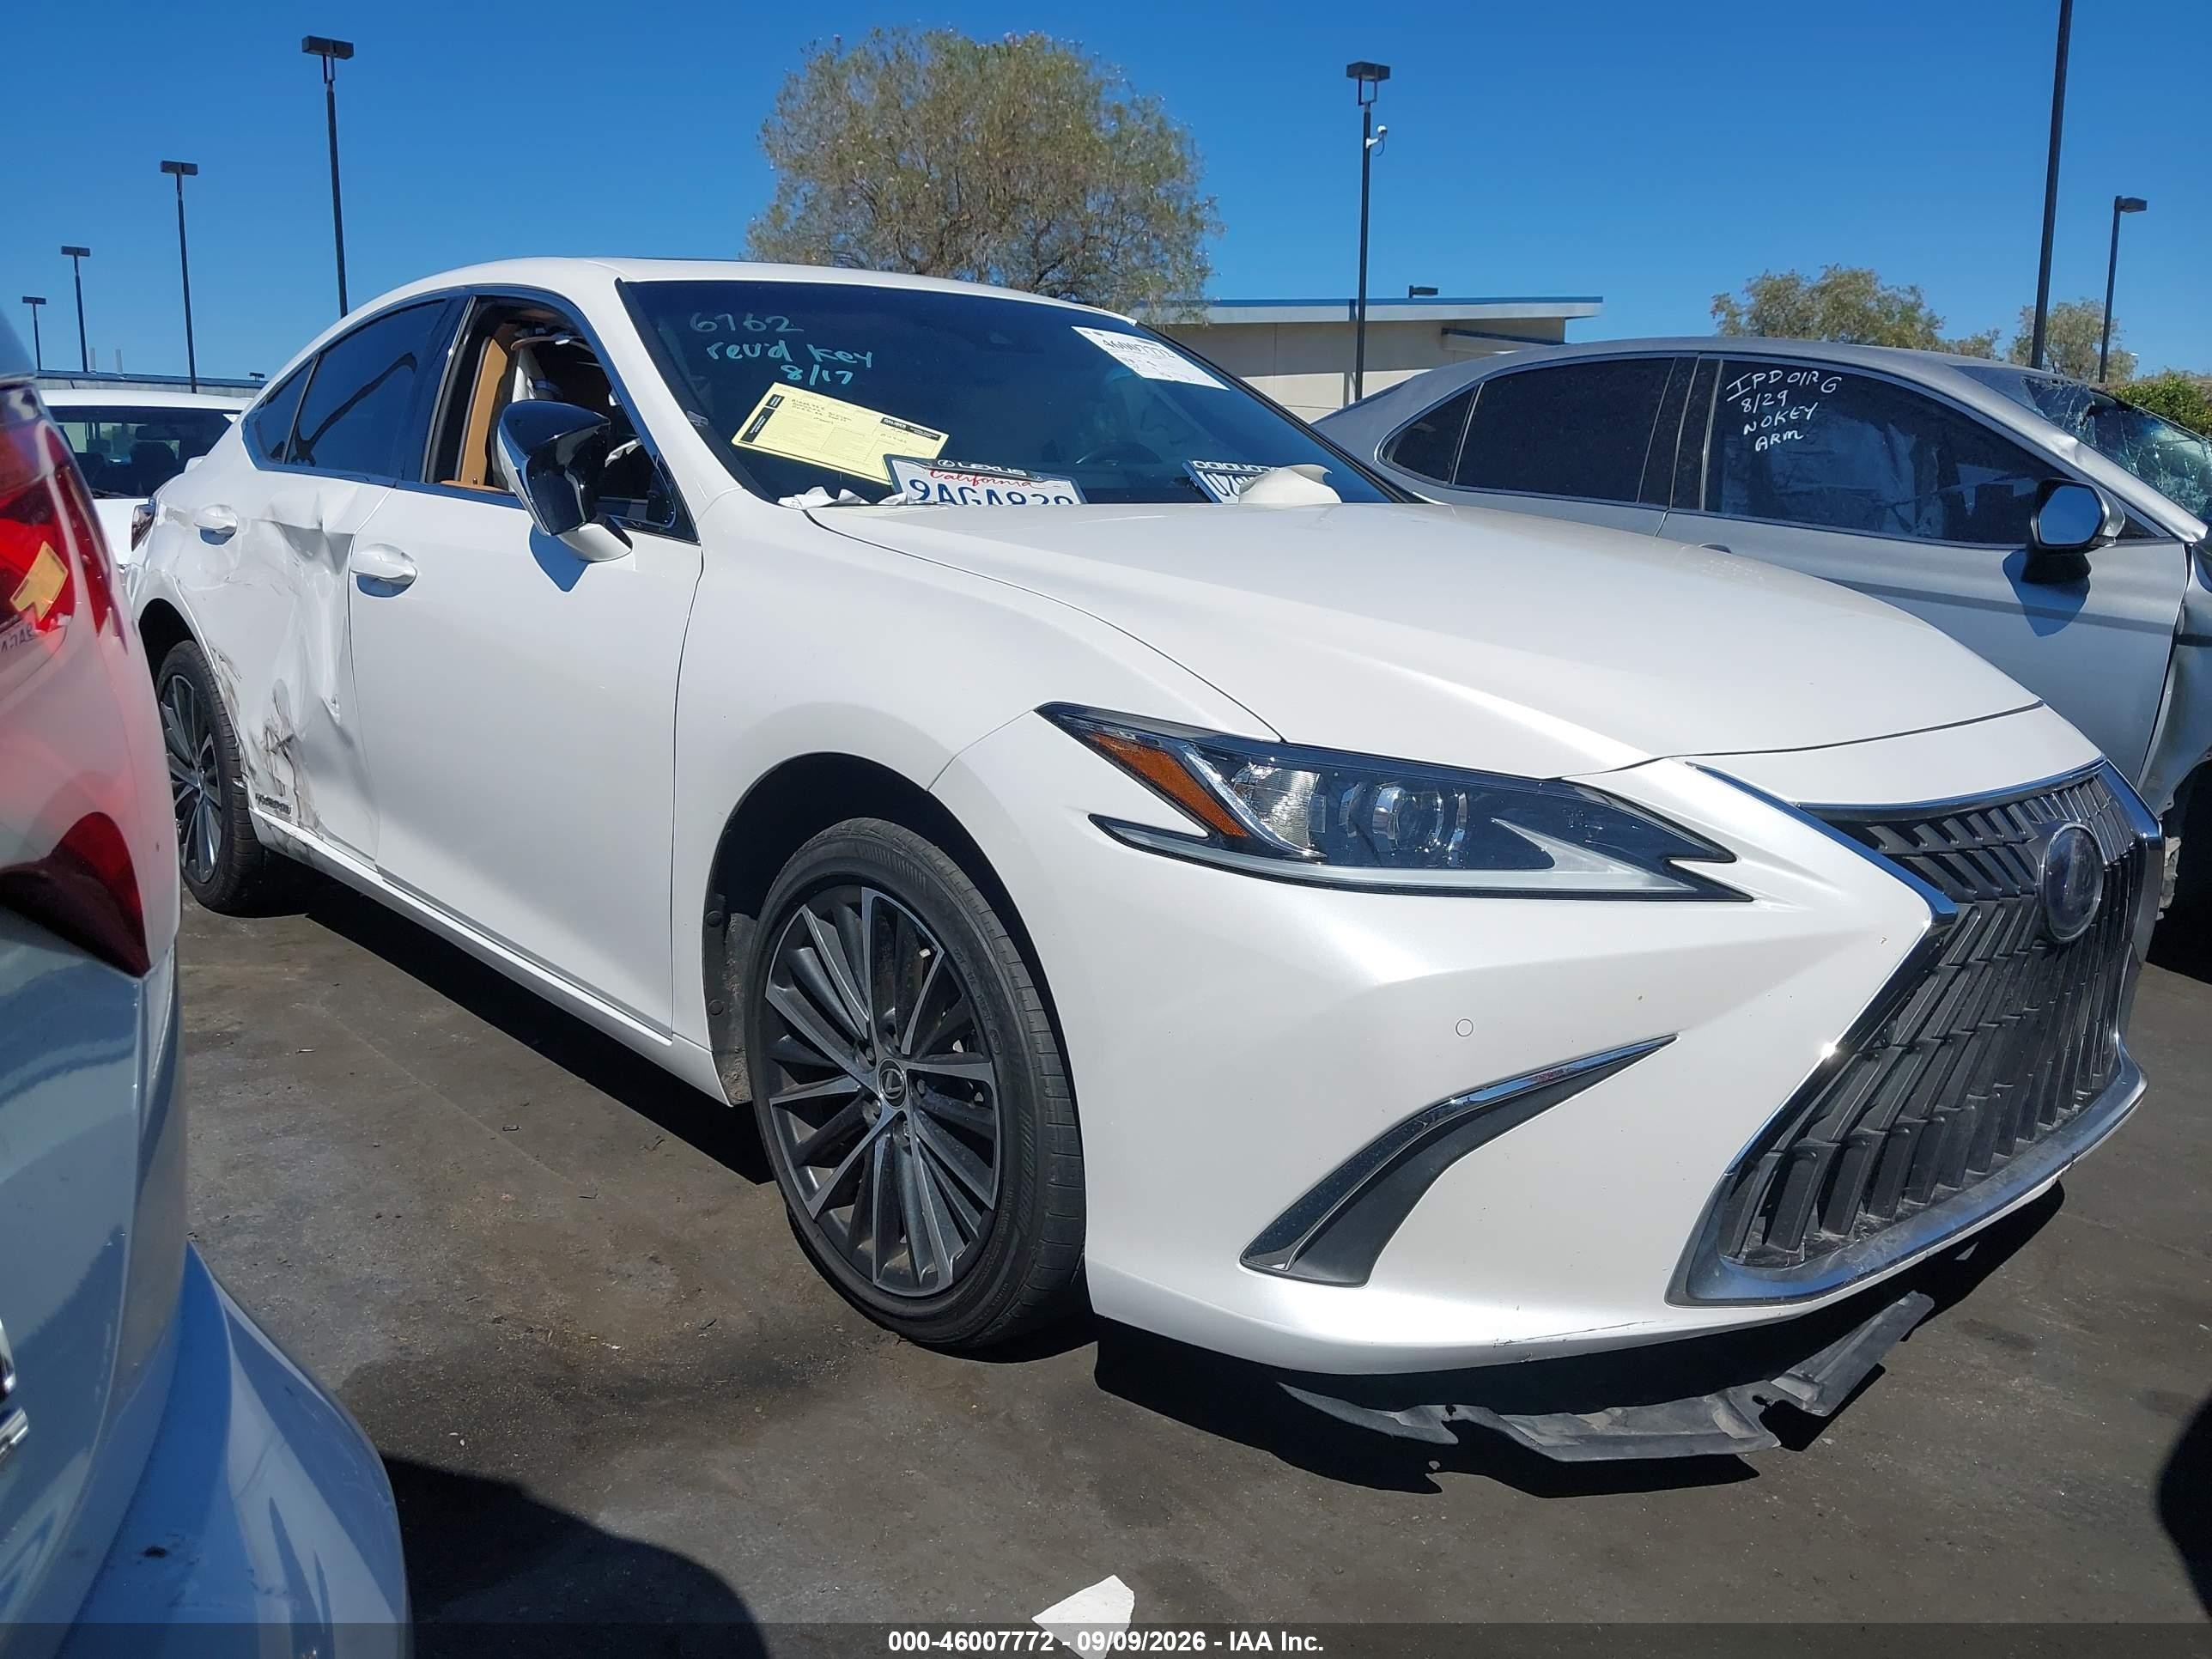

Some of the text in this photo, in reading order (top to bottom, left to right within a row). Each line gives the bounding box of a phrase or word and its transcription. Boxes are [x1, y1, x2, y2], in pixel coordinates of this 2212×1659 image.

[690, 313, 804, 332] 6762
[781, 364, 854, 386] 8/17
[1741, 389, 1789, 414] 8/29
[957, 461, 1027, 477] LEXUS
[929, 470, 1045, 488] California
